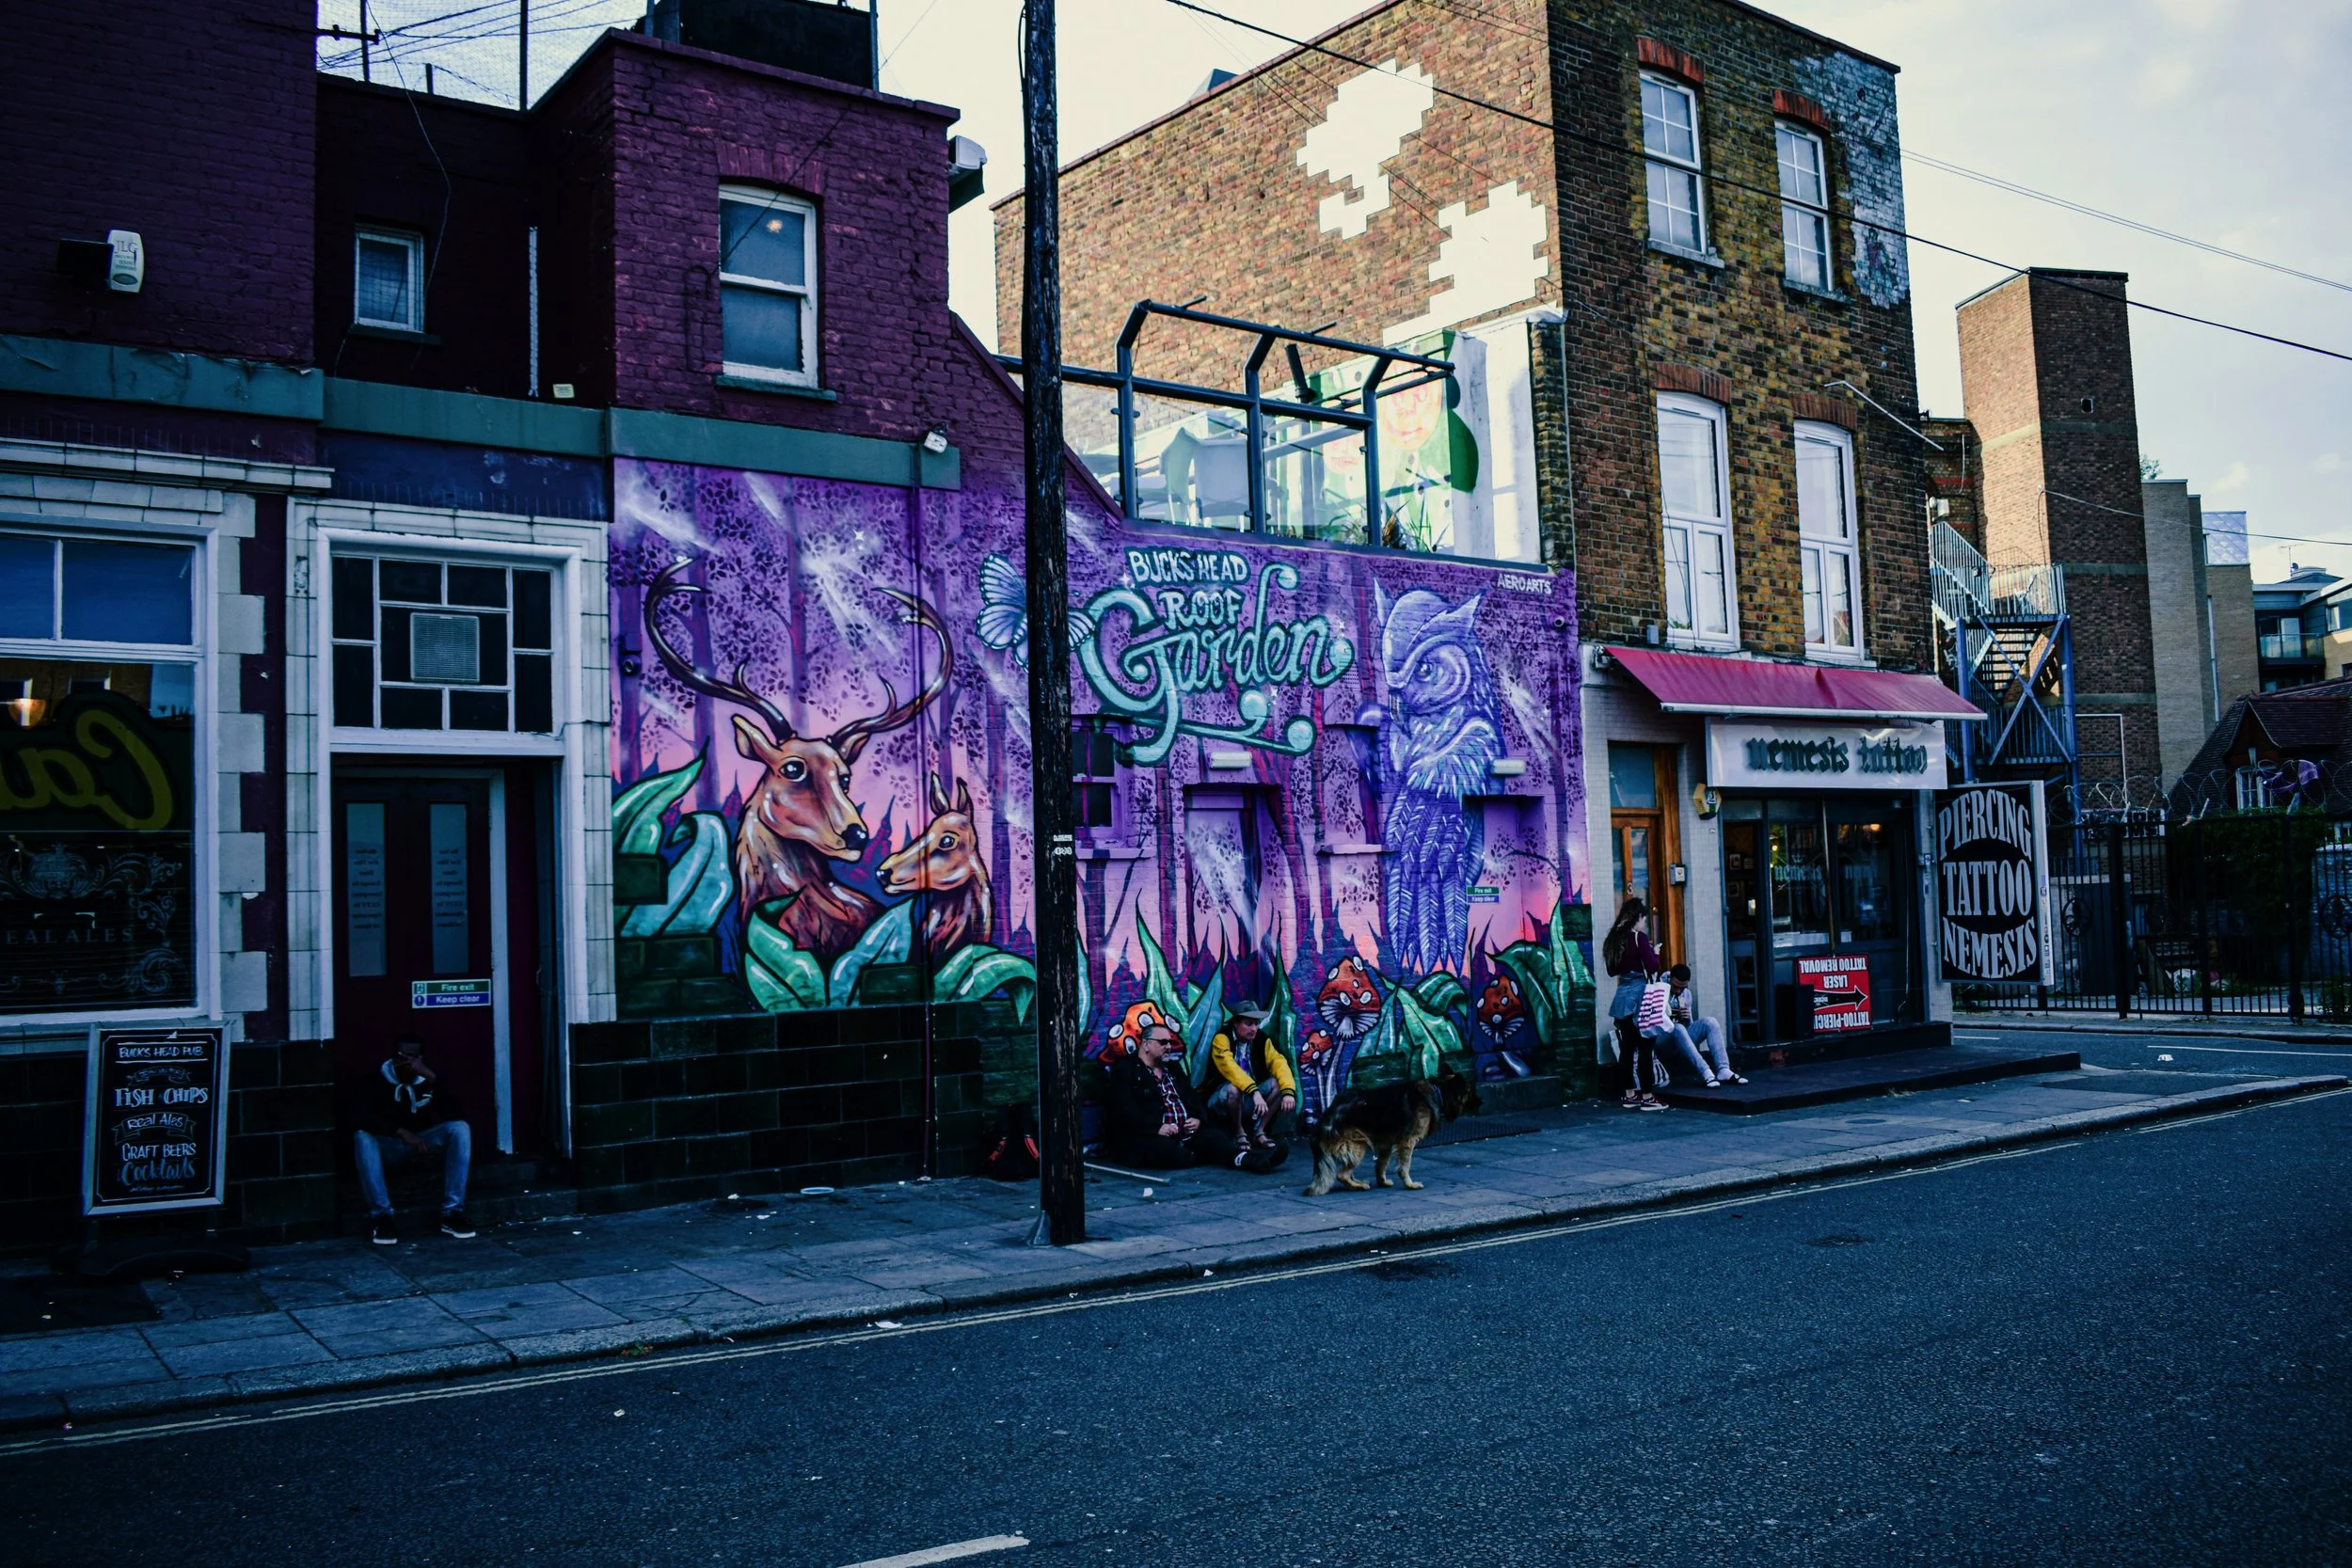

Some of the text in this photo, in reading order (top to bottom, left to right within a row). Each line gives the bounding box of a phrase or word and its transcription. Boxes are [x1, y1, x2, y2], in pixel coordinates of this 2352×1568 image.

[114, 240, 138, 254] JLG
[1197, 551, 1248, 582] HEAD
[1157, 588, 1243, 630] ROOF
[1081, 562, 1354, 764] Garden
[1747, 736, 1928, 774] nemesis tattoo
[1938, 788, 2032, 863] PIERCING
[1626, 881, 1634, 895] 3
[1943, 859, 2033, 917] TATTOO
[65, 927, 134, 942] ALES
[1942, 915, 2037, 979] NEMESIS
[1799, 957, 1867, 974] TATTOO REMOVAL
[1822, 974, 1849, 989] LASER
[436, 994, 480, 1005] Keep clear
[153, 1046, 181, 1057] HEAD
[183, 1046, 203, 1055] PUB
[163, 1086, 209, 1104] CHIPS
[127, 1113, 183, 1130] Real Ales
[122, 1142, 197, 1162] CRAFT BEERS
[121, 1156, 196, 1186] Cocktails
